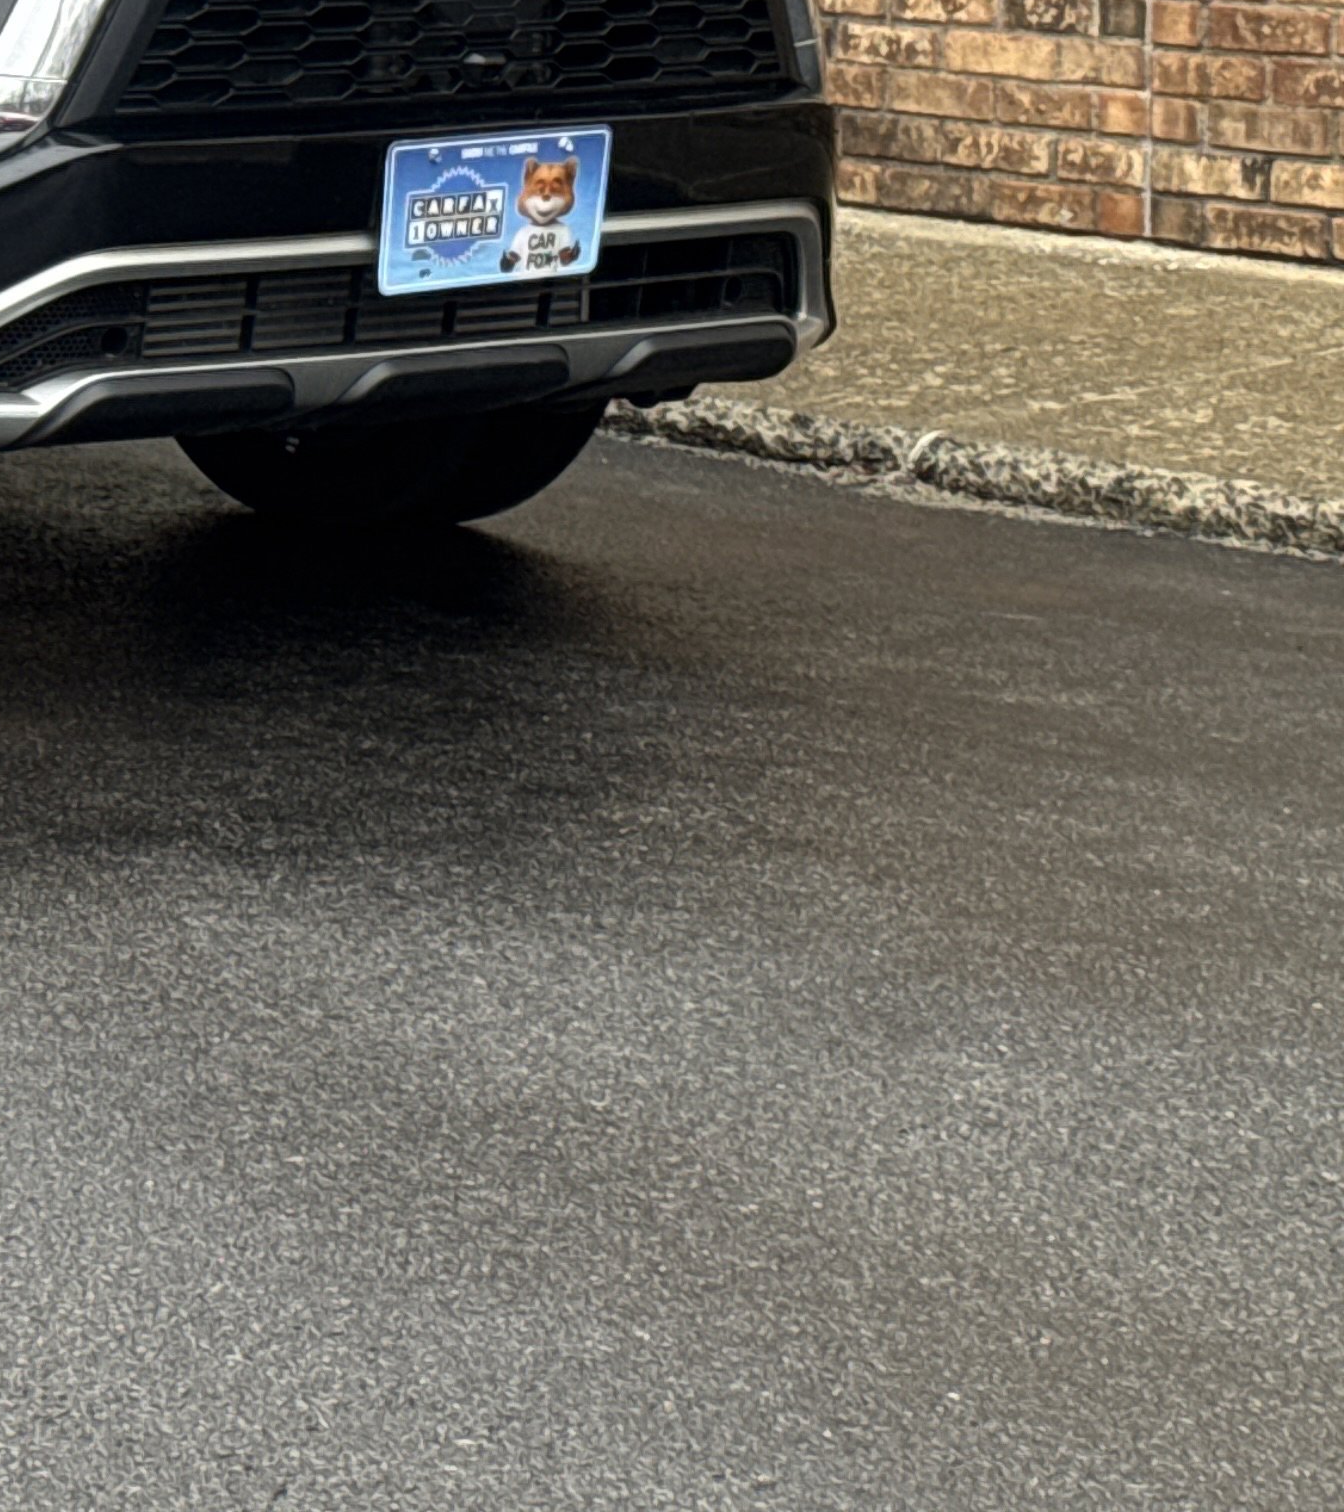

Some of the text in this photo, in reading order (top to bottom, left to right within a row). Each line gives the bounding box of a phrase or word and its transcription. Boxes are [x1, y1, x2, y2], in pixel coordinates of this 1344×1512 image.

[413, 190, 503, 217] CARFAX
[426, 217, 499, 240] OWNER
[528, 232, 557, 251] CAR
[526, 252, 553, 272] FOX
